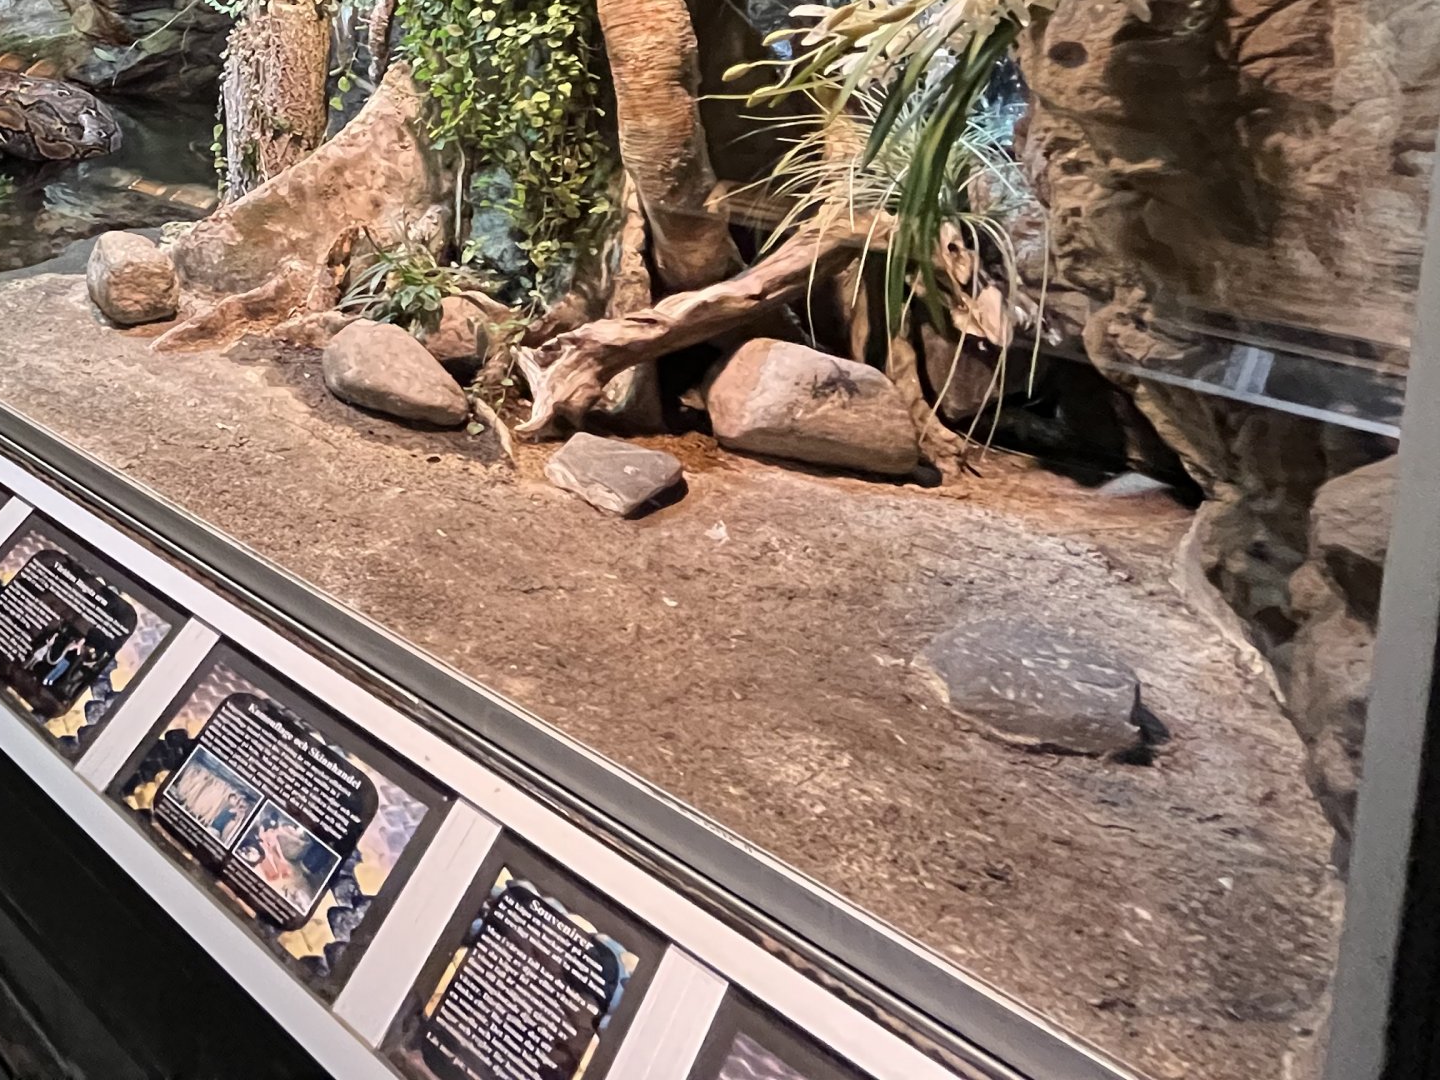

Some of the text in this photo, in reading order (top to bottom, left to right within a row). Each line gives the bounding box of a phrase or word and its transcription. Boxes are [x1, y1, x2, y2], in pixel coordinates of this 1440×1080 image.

[294, 736, 308, 751] och
[309, 746, 362, 790] Skinnhandel
[530, 900, 593, 950] Souvenirer
